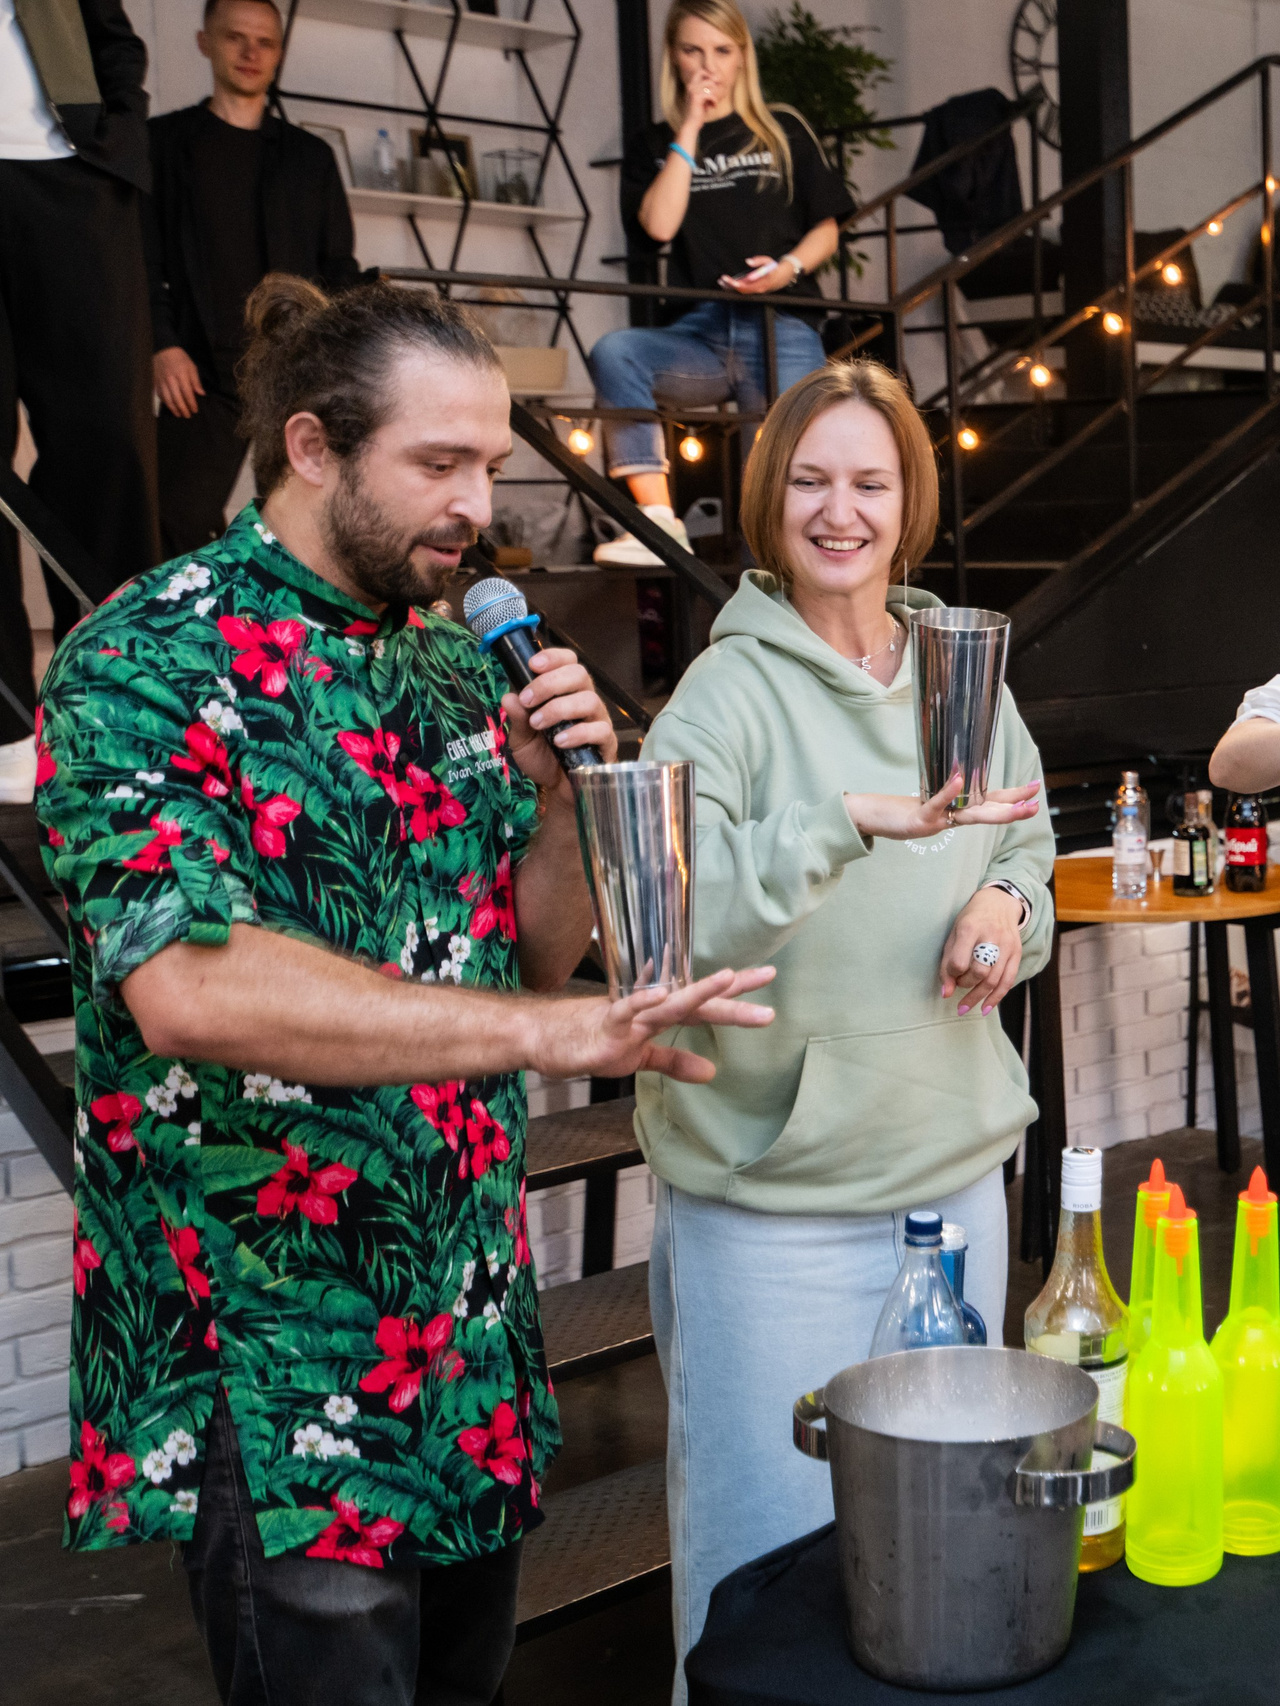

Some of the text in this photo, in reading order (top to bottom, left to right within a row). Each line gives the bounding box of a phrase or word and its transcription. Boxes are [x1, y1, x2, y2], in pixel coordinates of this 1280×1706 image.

[448, 767, 473, 783] Ivan
[904, 828, 955, 855] ПУТЬ ДВИ
